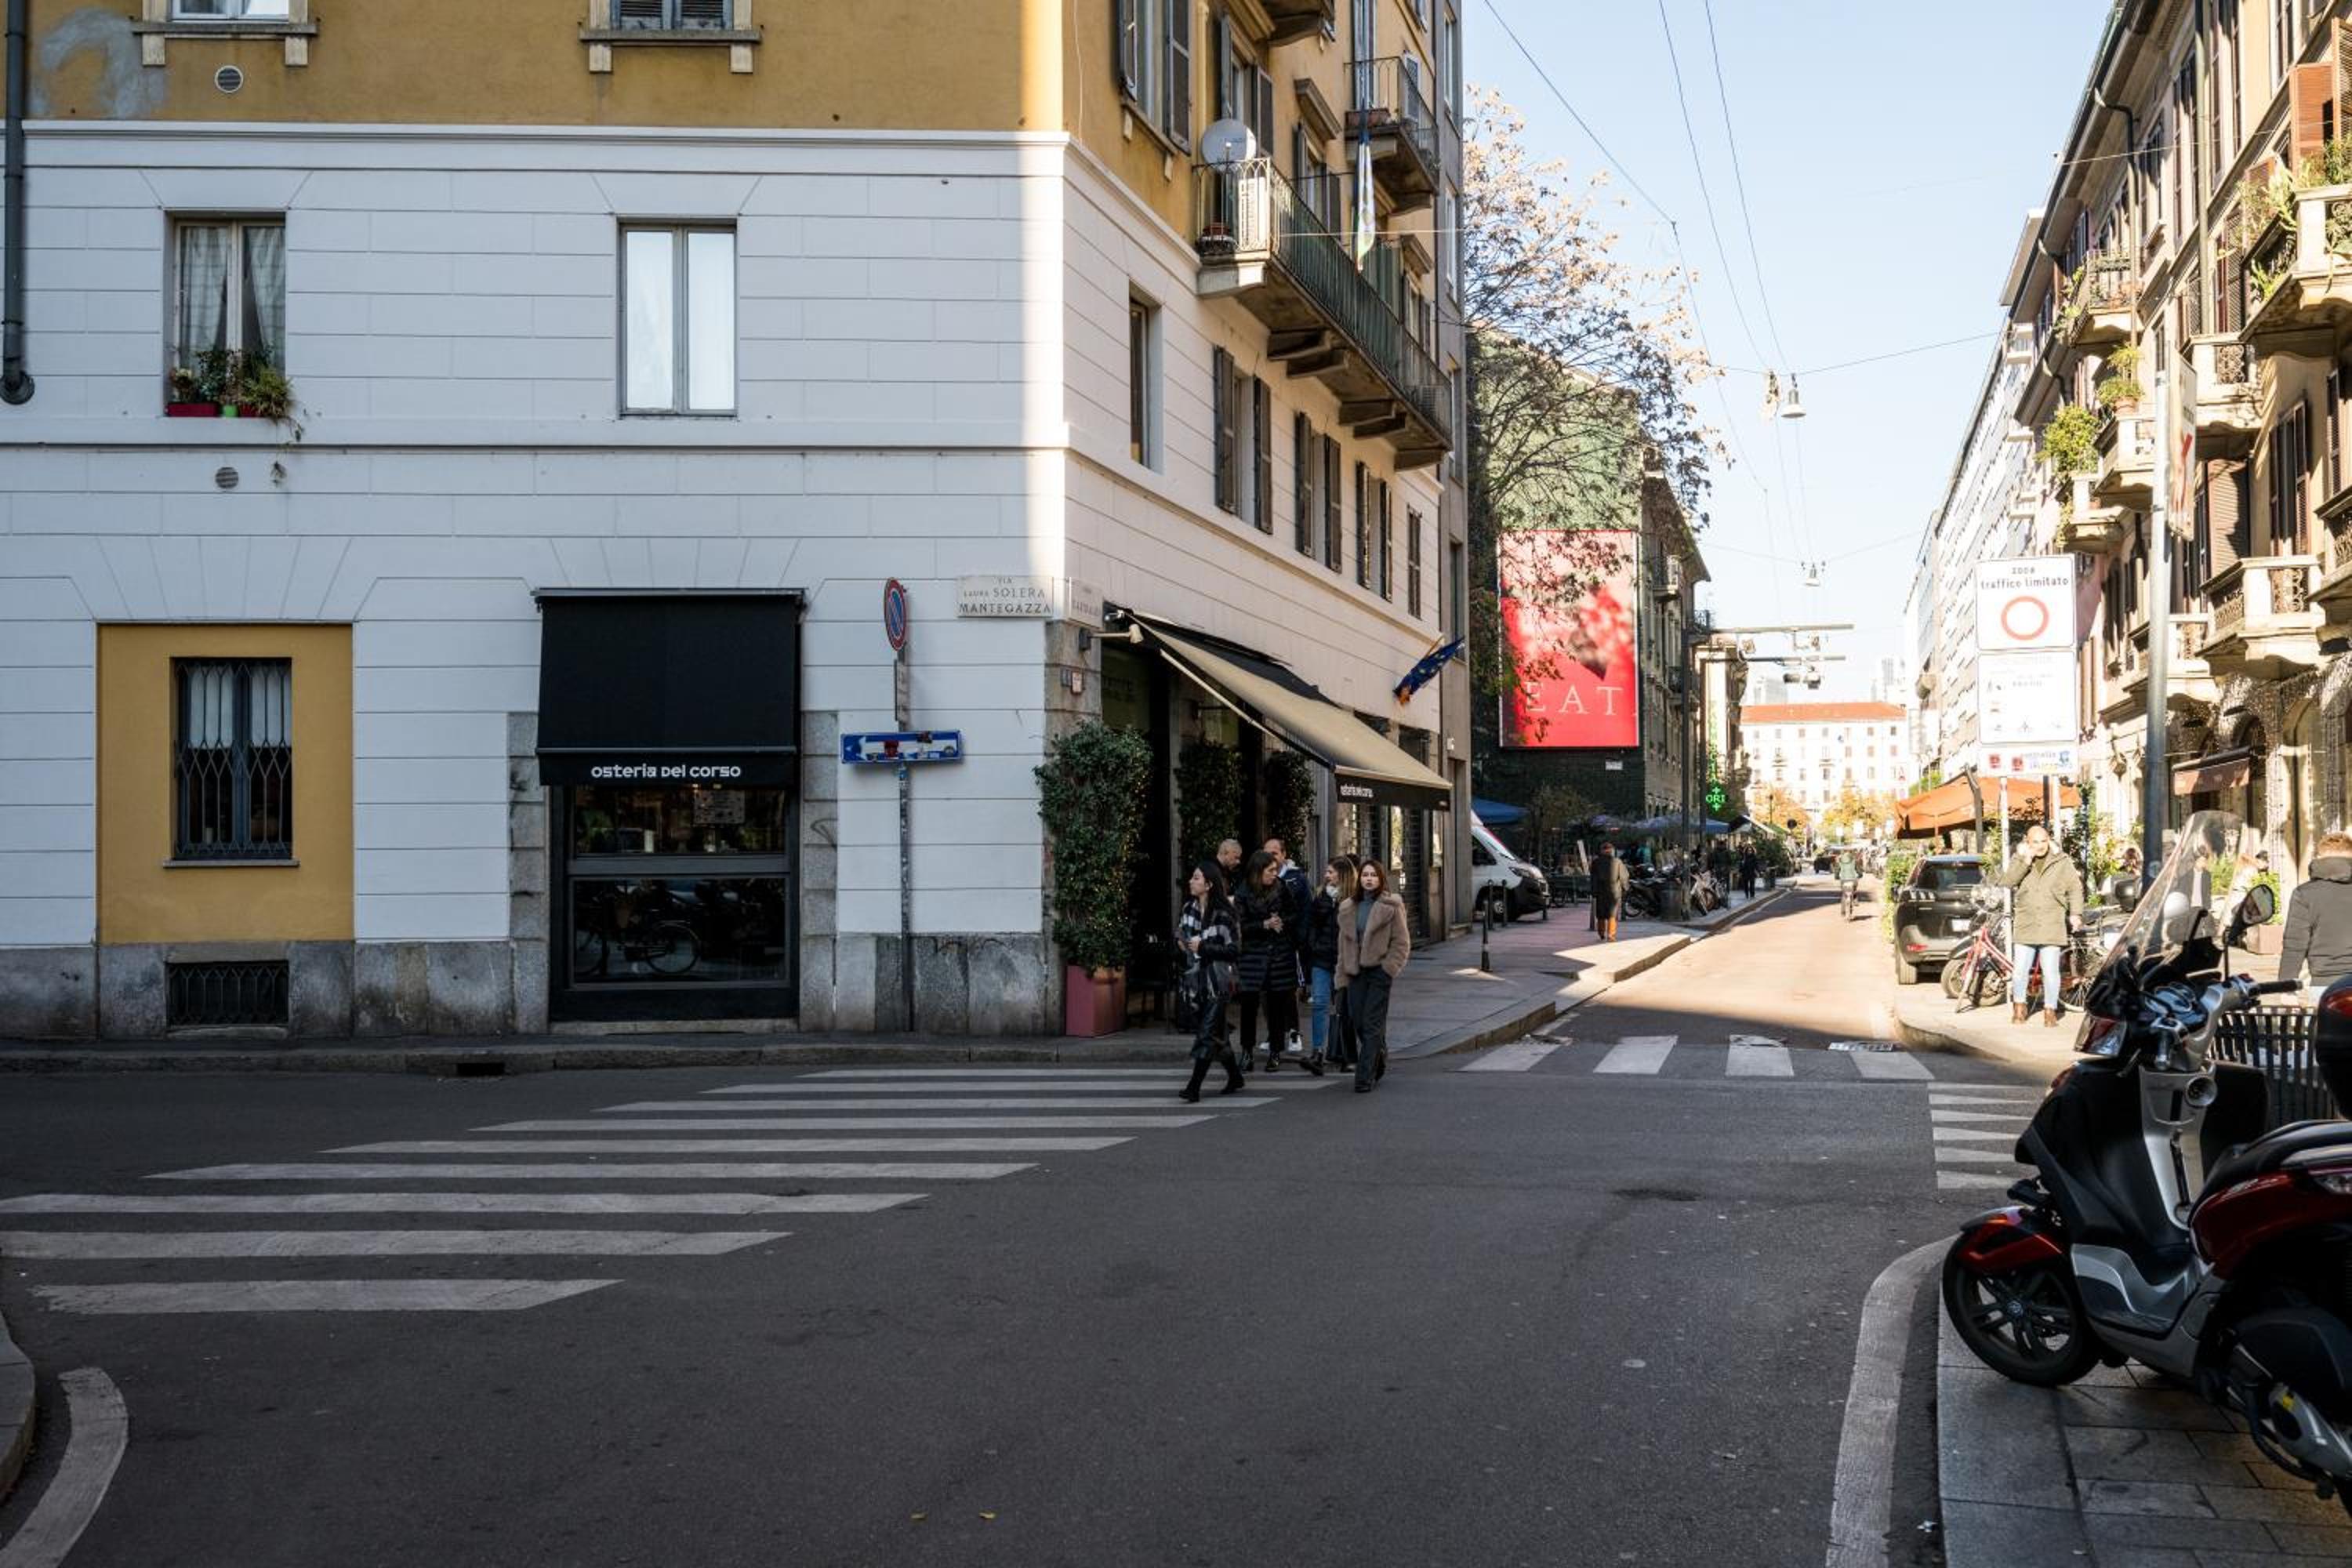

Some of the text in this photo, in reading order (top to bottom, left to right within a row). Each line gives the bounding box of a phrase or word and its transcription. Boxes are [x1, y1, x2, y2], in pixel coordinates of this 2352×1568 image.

[1980, 576, 2069, 590] traffico limitato
[993, 588, 1045, 598] SOLERA
[959, 603, 1051, 614] MANTEGAZZA
[1524, 681, 1637, 716] EAT
[591, 763, 657, 778] osteria
[689, 765, 742, 778] corso
